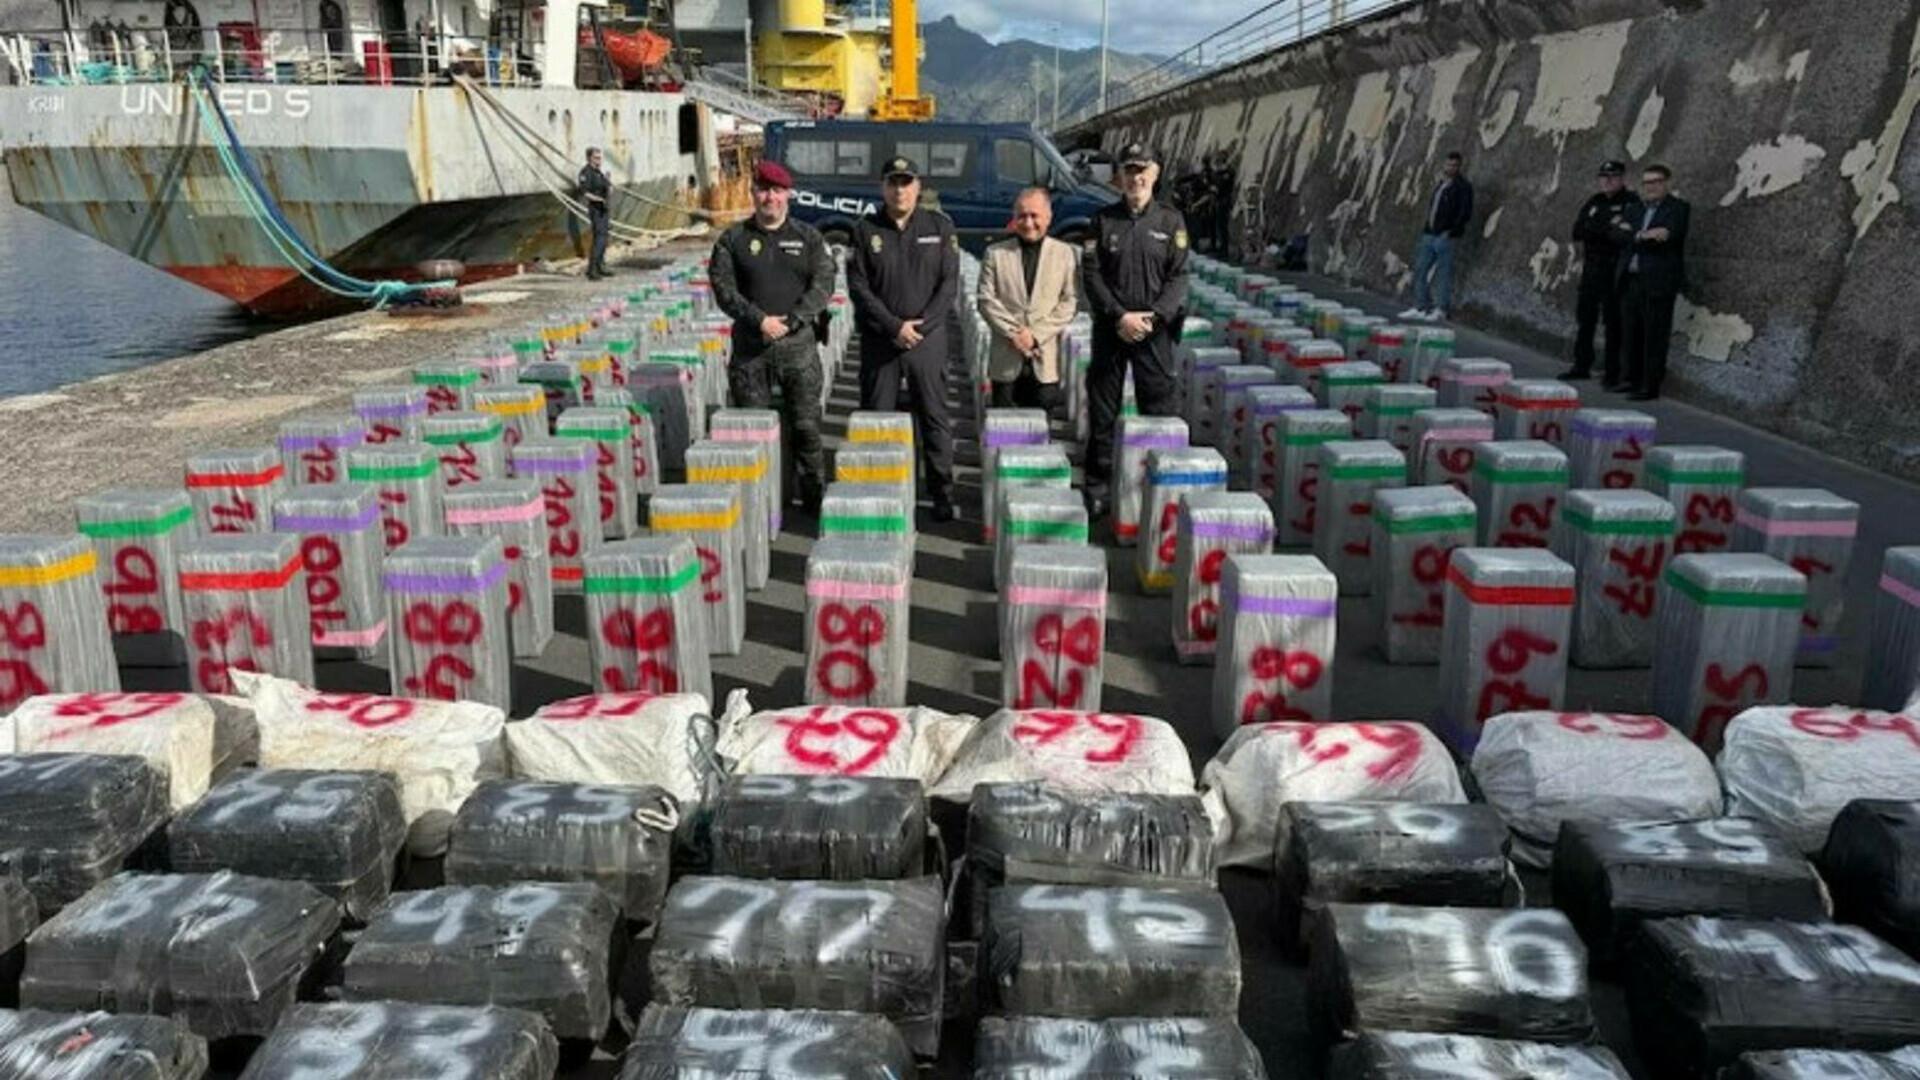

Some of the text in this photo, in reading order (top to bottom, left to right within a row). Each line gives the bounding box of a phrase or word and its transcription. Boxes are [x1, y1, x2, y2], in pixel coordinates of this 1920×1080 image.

[121, 84, 311, 118] UNIED S
[816, 603, 885, 698] 80
